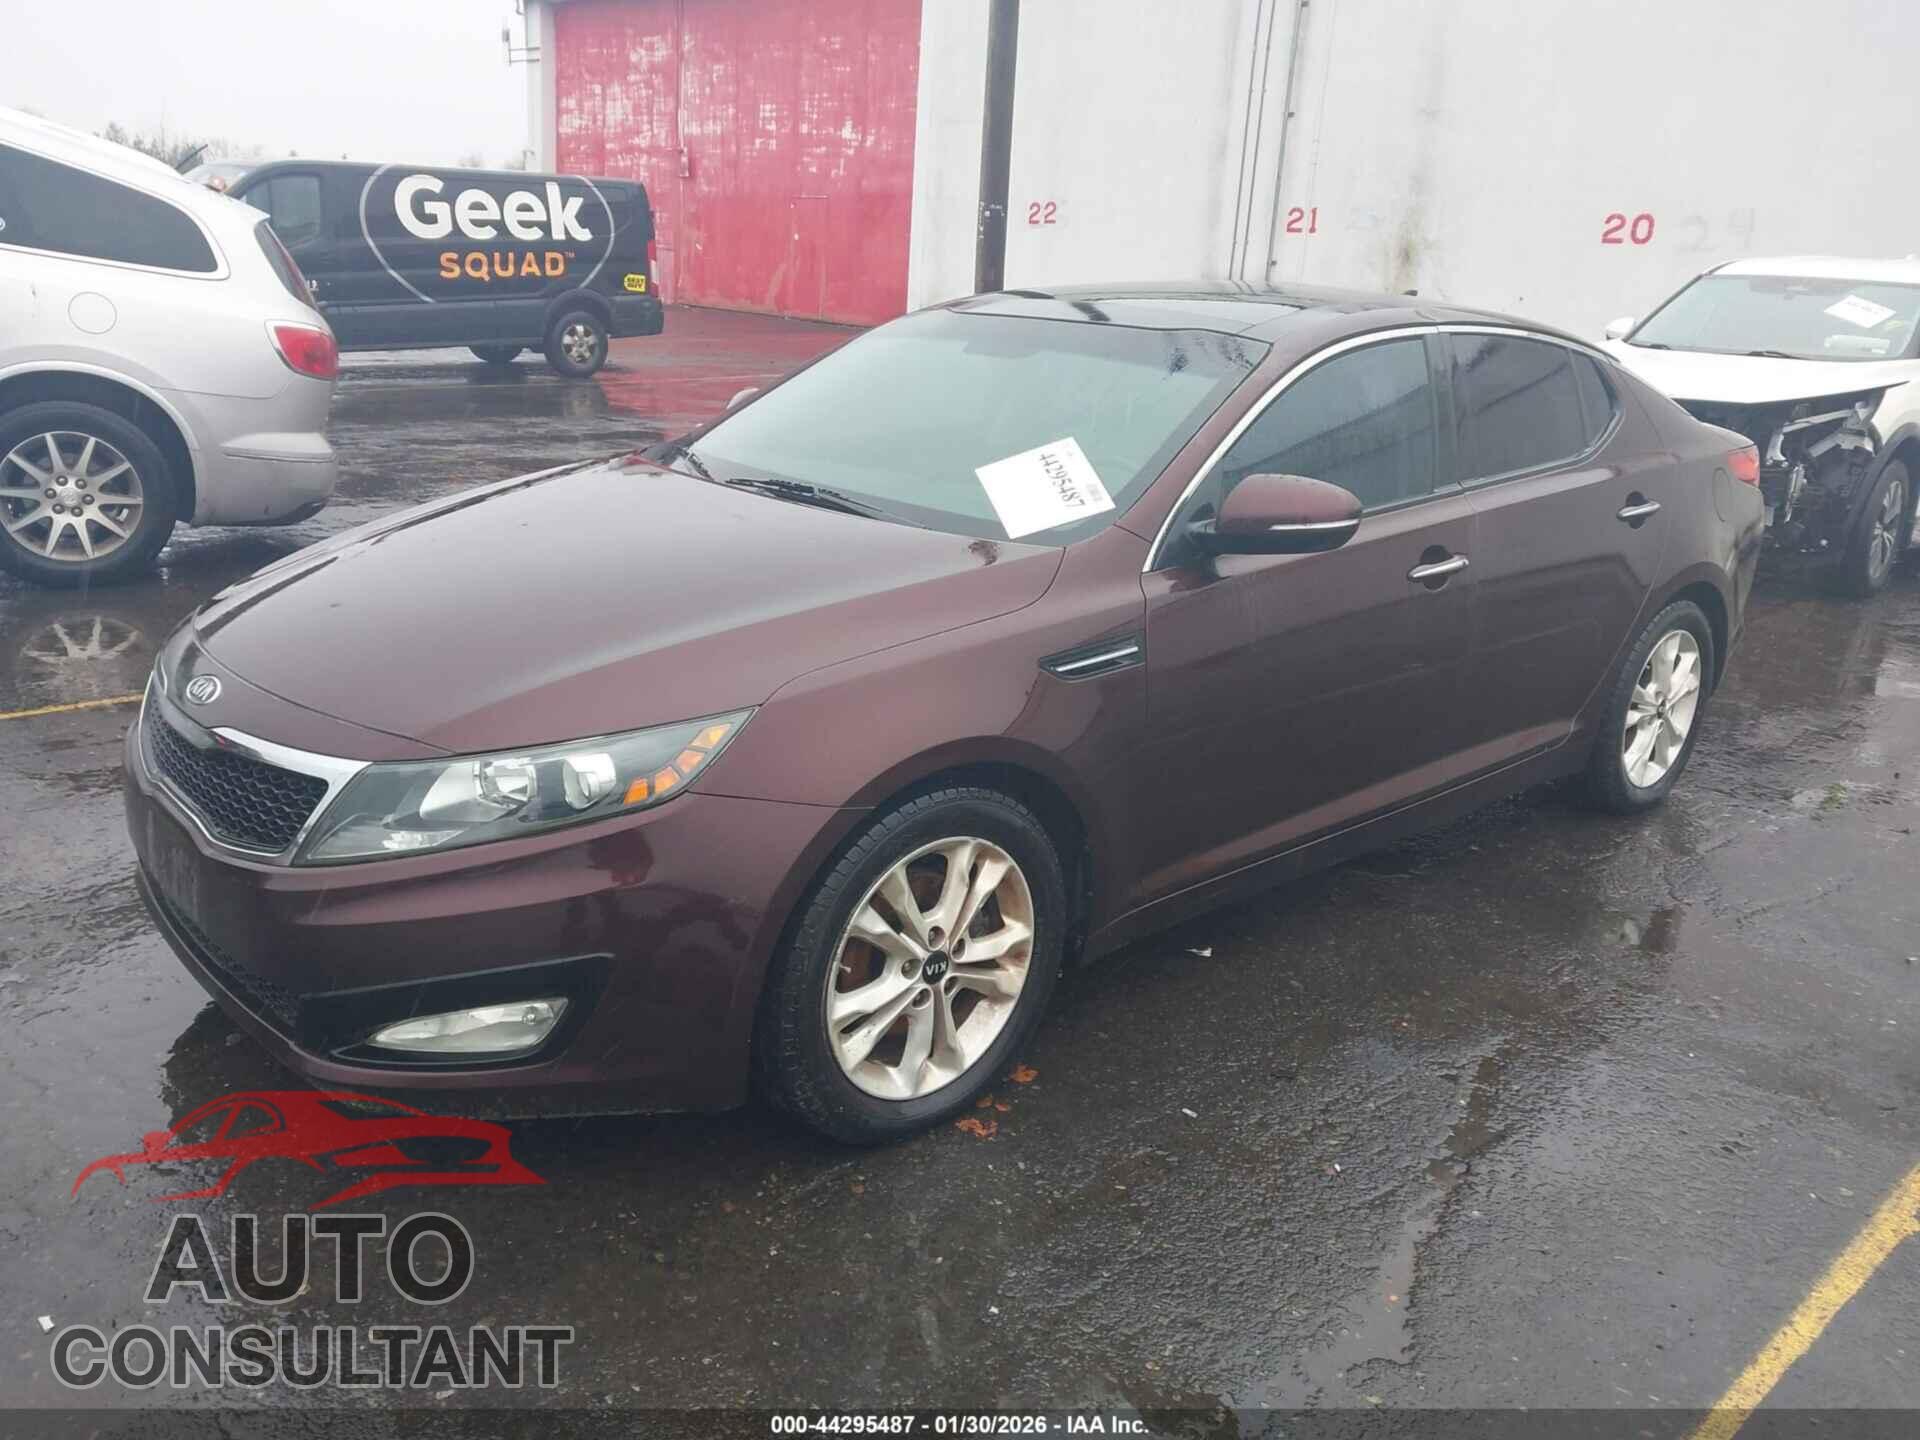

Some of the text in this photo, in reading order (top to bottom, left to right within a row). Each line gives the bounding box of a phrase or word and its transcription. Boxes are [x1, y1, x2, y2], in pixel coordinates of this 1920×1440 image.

[394, 174, 593, 242] Geek
[1028, 201, 1057, 225] 22
[1286, 207, 1318, 233] 21
[1601, 213, 1655, 245] 20
[439, 252, 566, 281] SQUAD
[1039, 453, 1086, 507] 44295487
